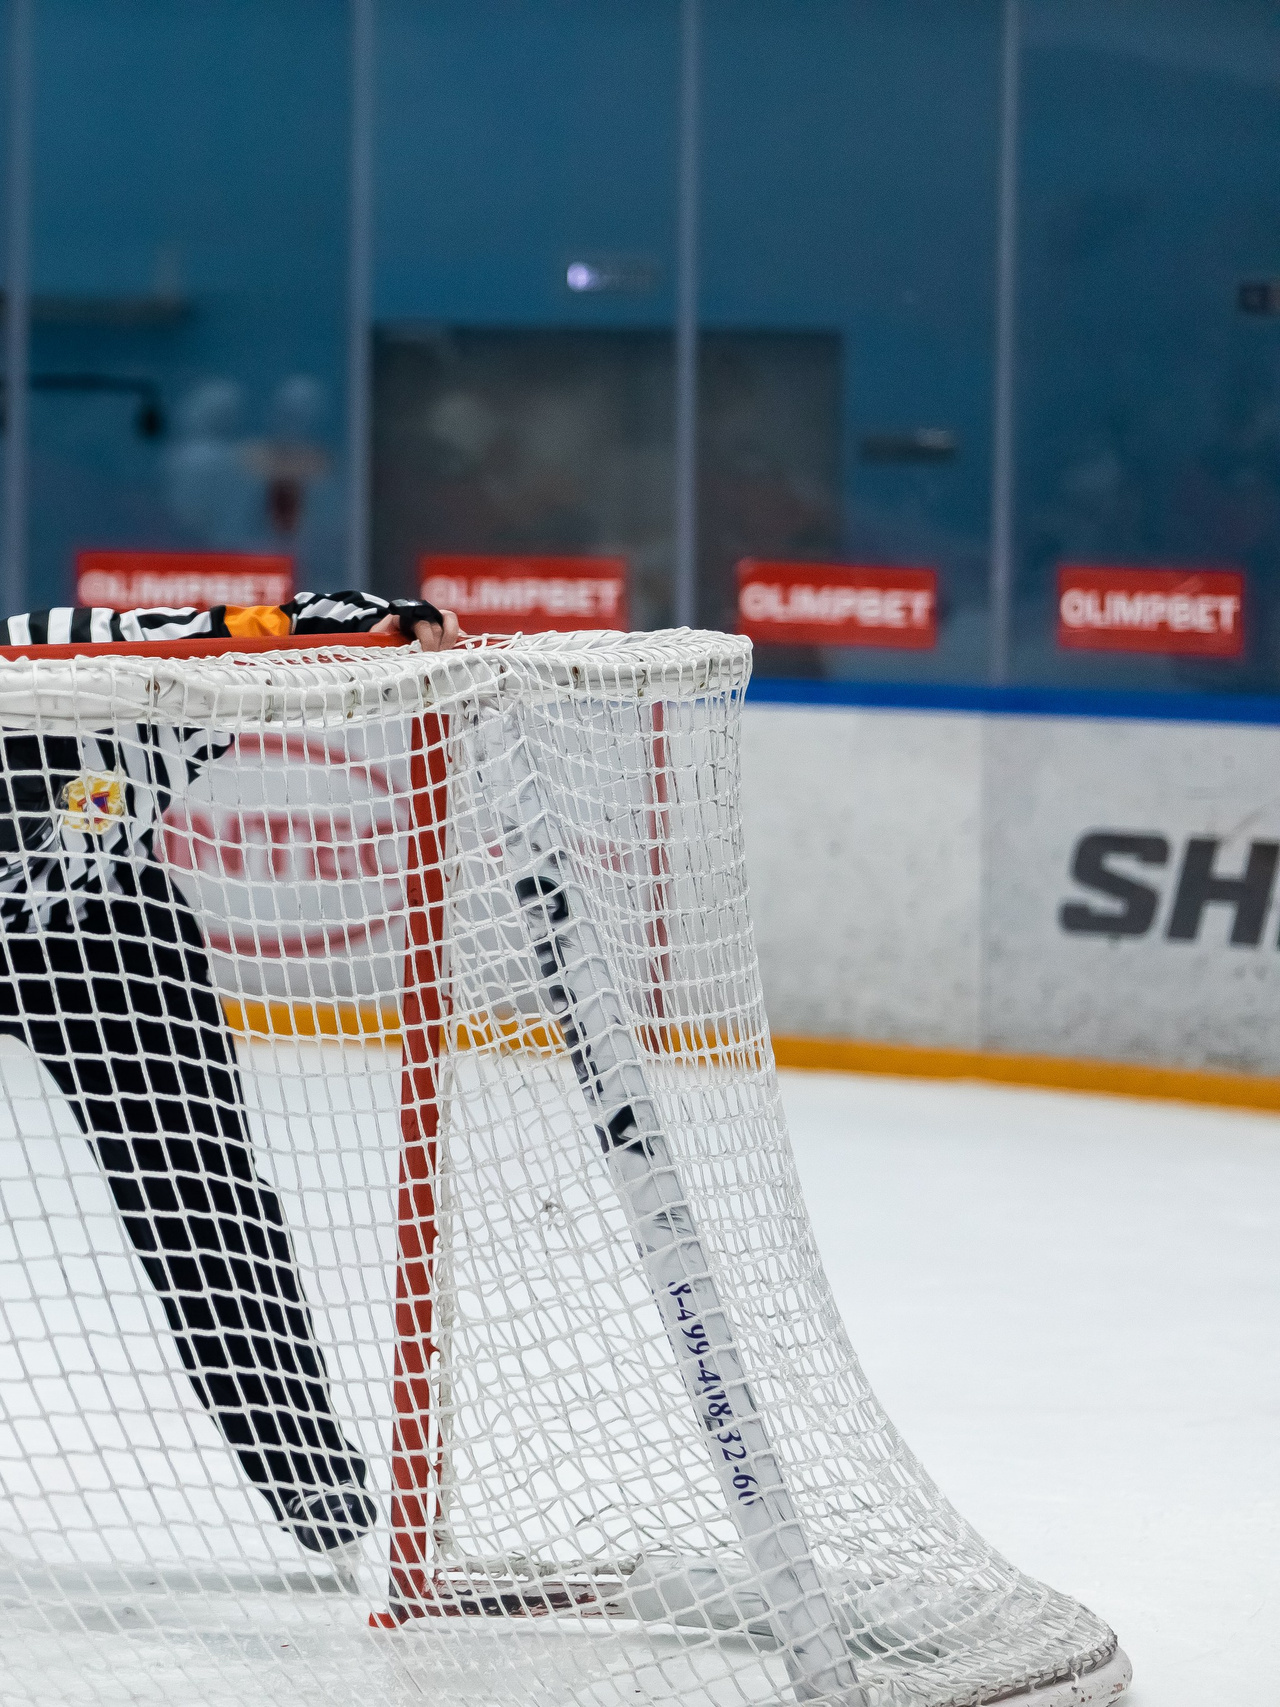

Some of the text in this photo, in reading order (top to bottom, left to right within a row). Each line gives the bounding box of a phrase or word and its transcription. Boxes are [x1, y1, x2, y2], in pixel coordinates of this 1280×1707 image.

[422, 576, 620, 617] OLIMPBET
[740, 582, 932, 629] OLIMPBET
[1061, 588, 1240, 634] OLIMPBET
[1058, 827, 1280, 950] SH
